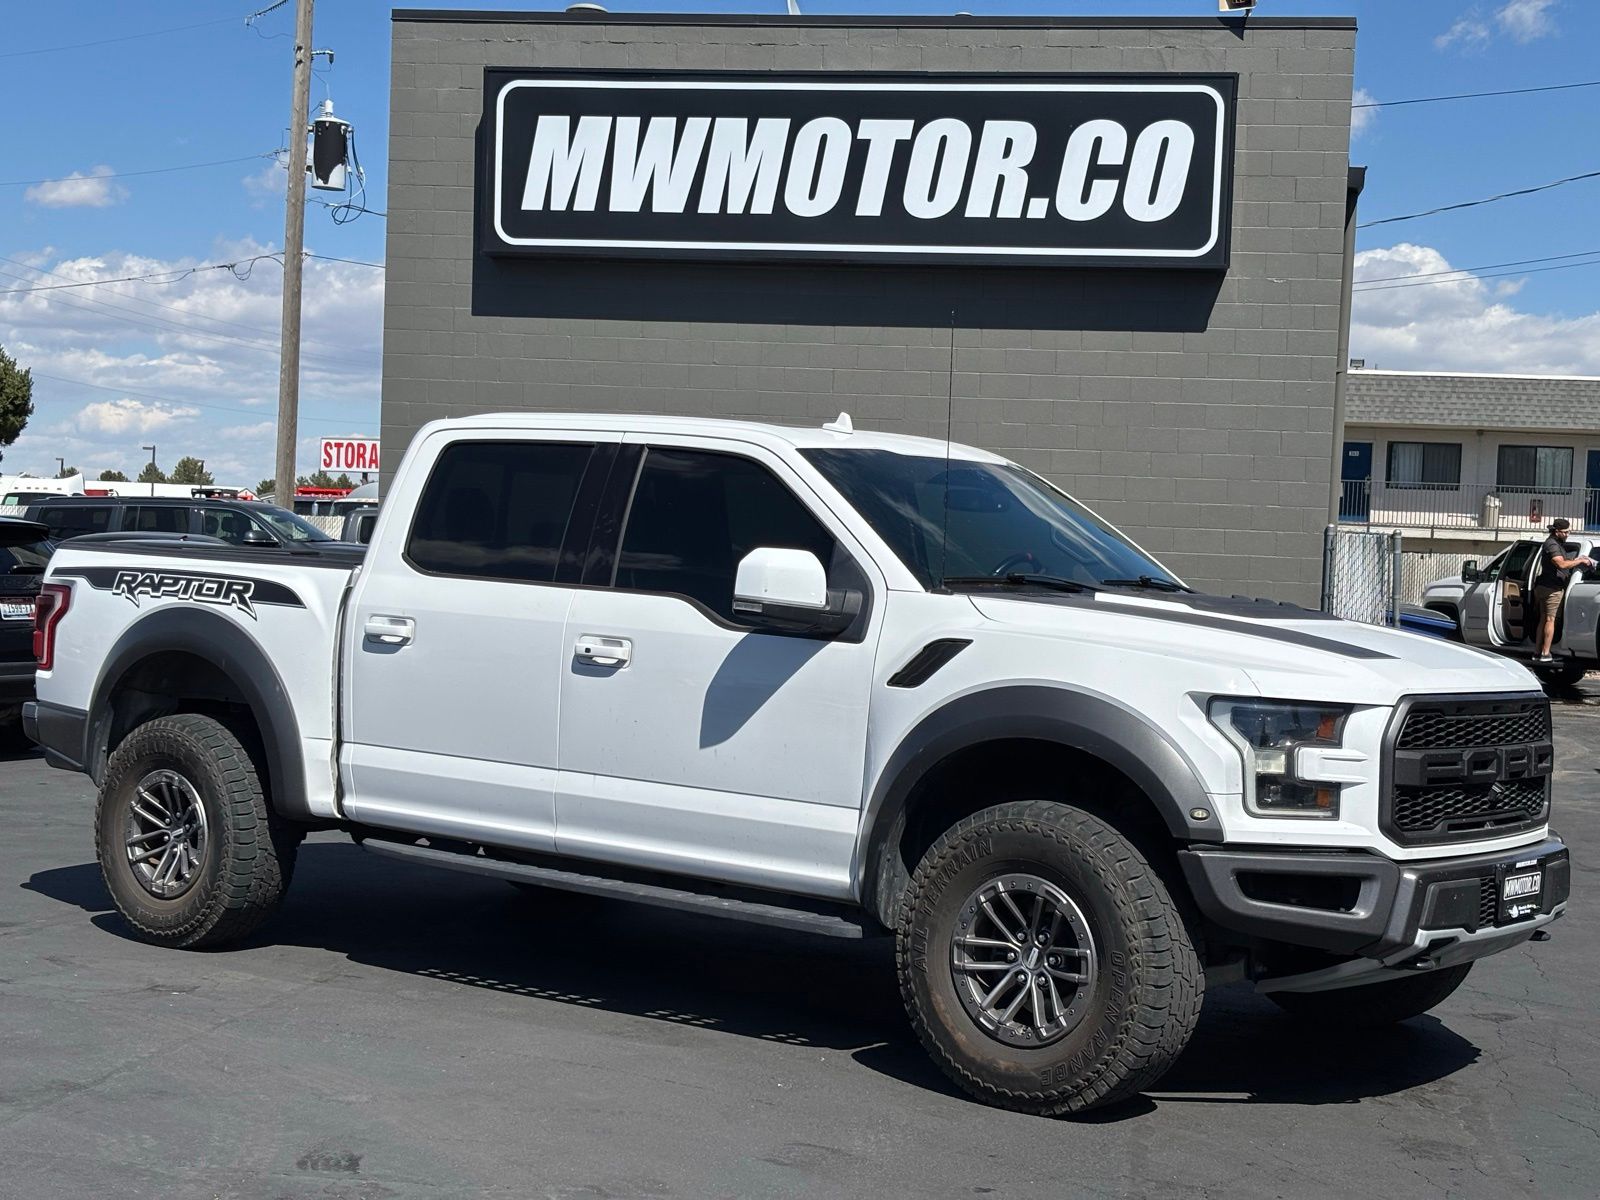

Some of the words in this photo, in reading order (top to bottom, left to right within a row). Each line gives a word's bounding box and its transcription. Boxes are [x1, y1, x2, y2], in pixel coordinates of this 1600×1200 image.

[521, 115, 1195, 222] MWMOTOR.CO
[112, 571, 257, 621] RAPTOR
[1395, 746, 1553, 786] FORD
[920, 837, 994, 917] TERRAIN
[914, 927, 929, 973] ALL
[1104, 951, 1126, 1024] OPEN
[1041, 1027, 1108, 1086] RANGE
